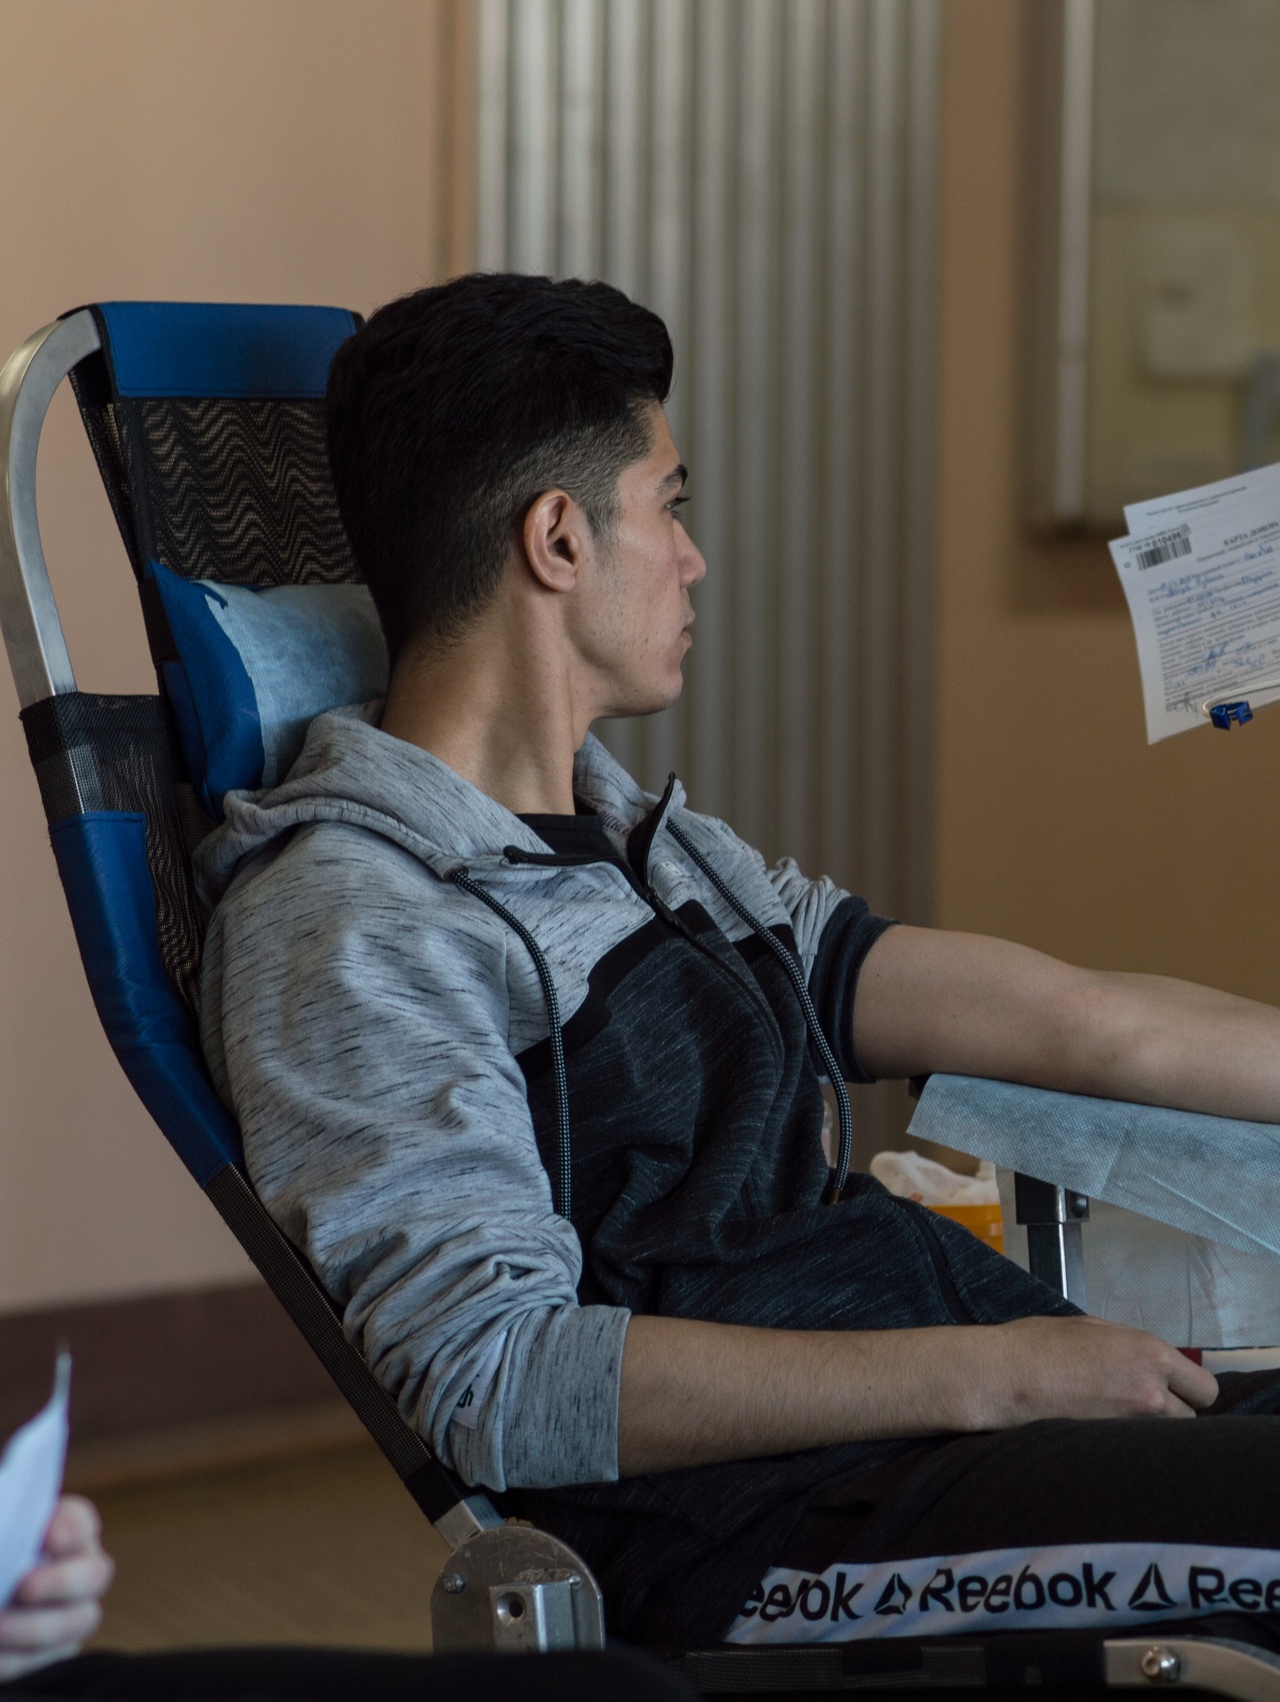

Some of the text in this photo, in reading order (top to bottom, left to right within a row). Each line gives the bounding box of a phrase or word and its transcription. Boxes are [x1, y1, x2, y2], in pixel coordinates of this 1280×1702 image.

[1151, 531, 1182, 547] 010496
[1223, 532, 1248, 546] КАРТА
[1249, 521, 1279, 537] ДОНОРА
[919, 1562, 1117, 1613] Reebok
